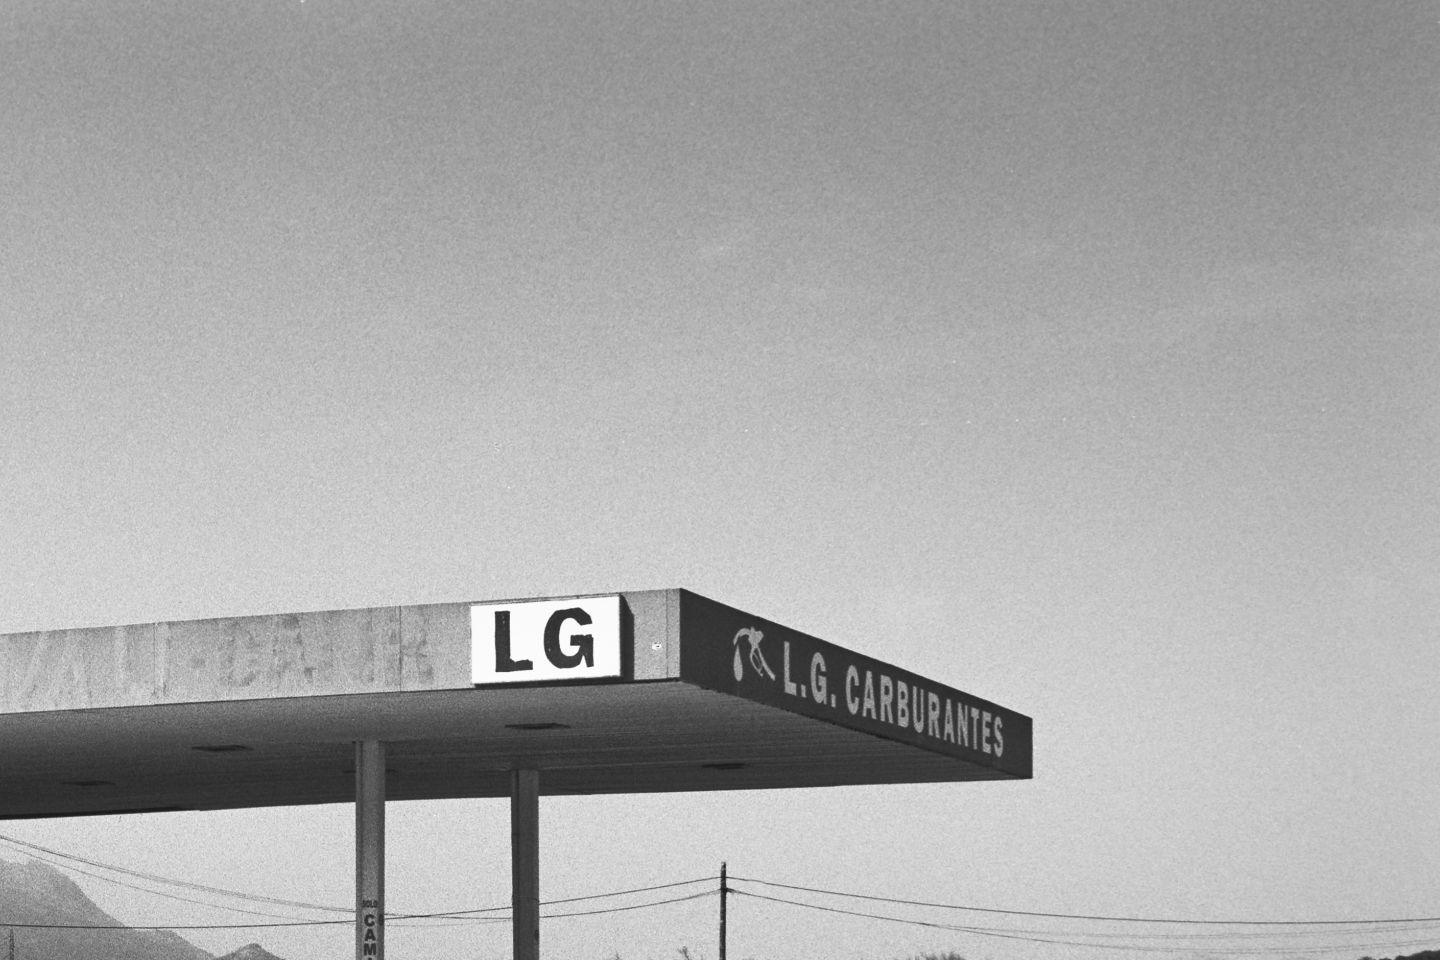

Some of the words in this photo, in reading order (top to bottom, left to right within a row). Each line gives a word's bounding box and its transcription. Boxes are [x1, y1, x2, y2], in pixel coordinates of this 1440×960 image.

[494, 606, 595, 673] LG
[783, 641, 836, 708] L.G.
[845, 664, 1003, 758] CARBURANTES
